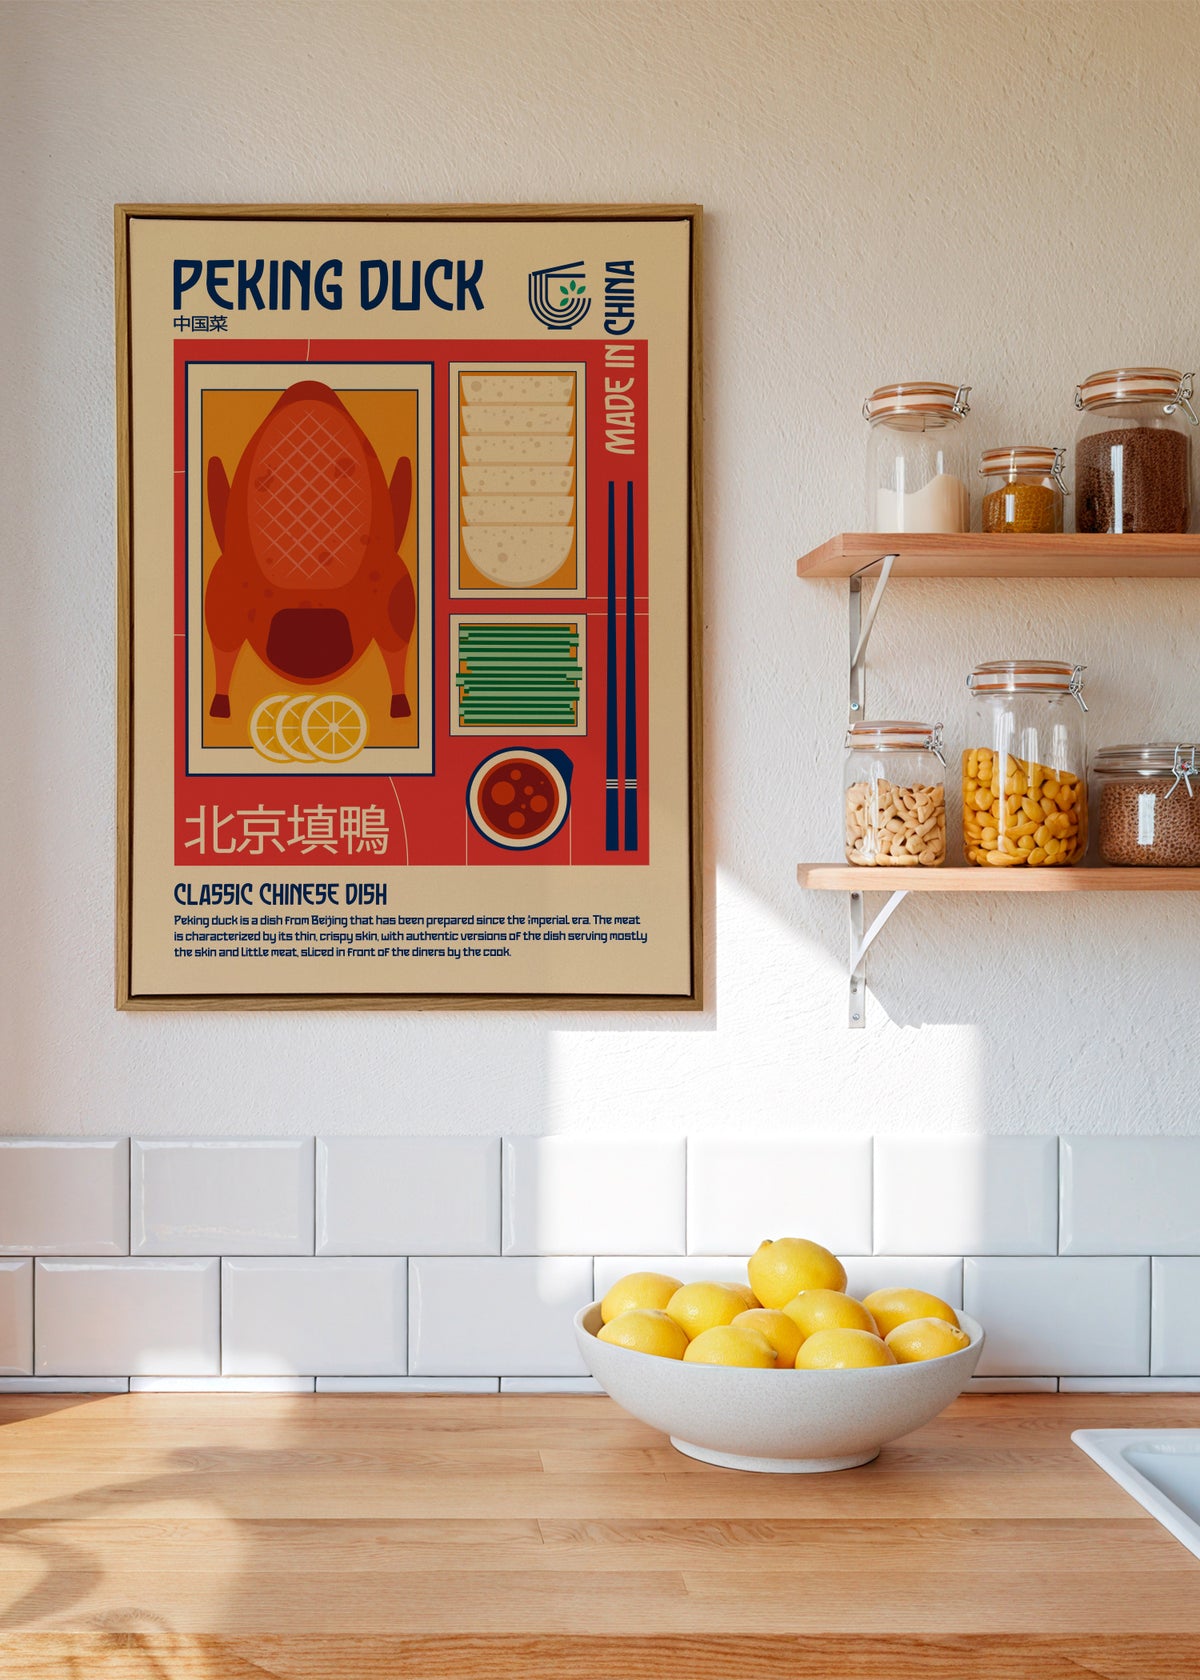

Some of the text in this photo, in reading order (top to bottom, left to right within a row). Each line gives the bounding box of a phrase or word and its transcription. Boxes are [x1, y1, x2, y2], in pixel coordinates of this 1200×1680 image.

[173, 259, 485, 311] PEKING DUCK
[173, 315, 229, 333] 中国菜
[603, 260, 635, 455] MADE IN CHINA
[184, 803, 390, 855] 北京填鴨
[173, 882, 388, 905] CLASSIC CHINESE DISH
[174, 915, 209, 928] Peking
[212, 915, 238, 925] duck
[240, 916, 249, 925] is
[260, 915, 282, 925] dish
[285, 916, 309, 925] from
[311, 915, 347, 928] Beijing
[350, 915, 374, 925] that
[376, 915, 396, 925] has
[398, 915, 424, 924] been
[427, 915, 474, 928] prepared
[477, 916, 505, 924] since
[507, 915, 525, 924] the
[528, 915, 570, 927] imperial
[593, 915, 612, 924] The
[614, 916, 640, 924] meat
[174, 931, 647, 944] is characterized by its thin, crispy skin, with authentic versions of the dish serving mostly
[174, 947, 511, 959] the skin and little meat, sliced in front of the diners by the cook.
